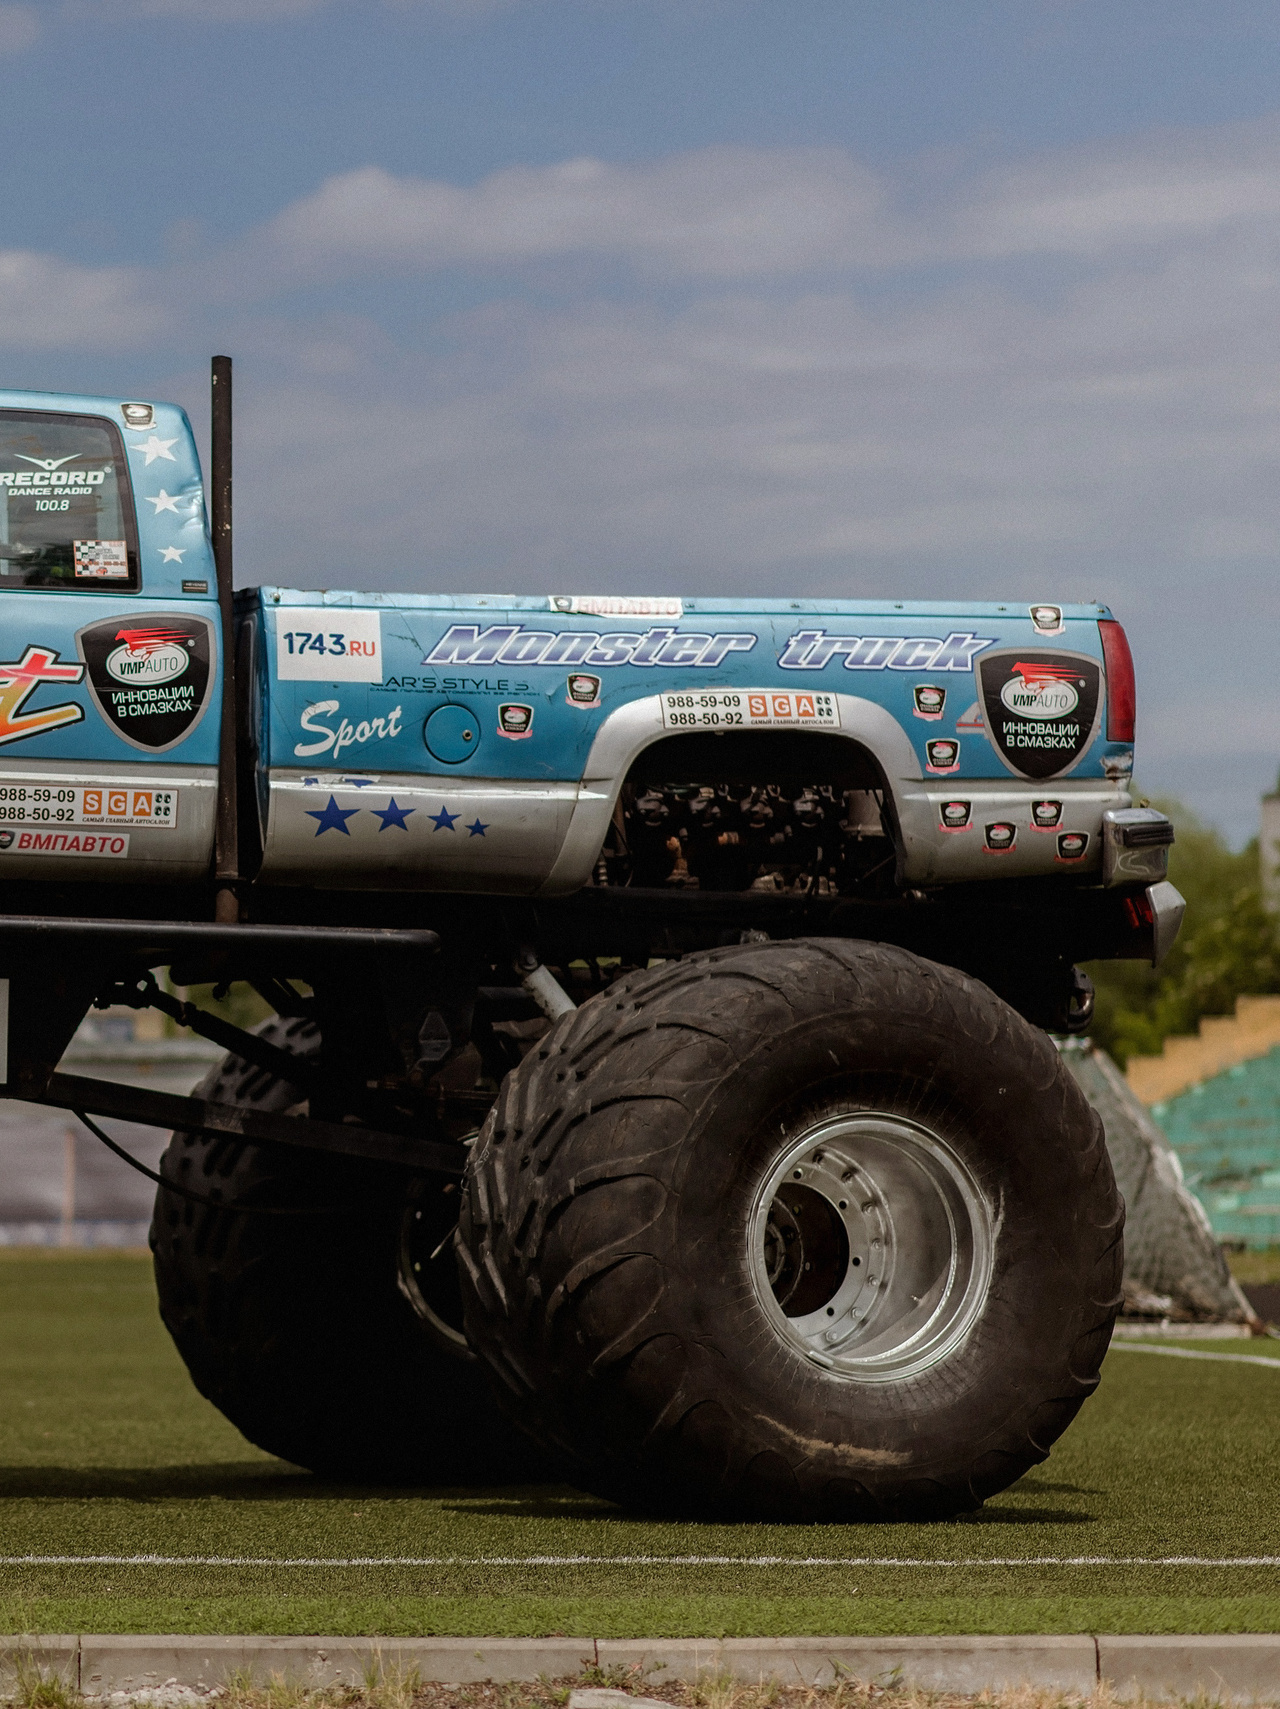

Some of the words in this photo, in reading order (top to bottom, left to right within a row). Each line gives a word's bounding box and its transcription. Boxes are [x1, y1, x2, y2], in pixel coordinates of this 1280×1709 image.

[8, 488, 52, 496] DANCE
[53, 487, 92, 495] RADIO
[35, 500, 70, 511] 100.8
[283, 632, 375, 656] 1743.RU
[422, 625, 757, 666] Monster
[778, 629, 1001, 672] truck
[119, 657, 178, 675] VMPAUTO
[371, 677, 437, 687] AR'S
[442, 679, 509, 691] STYLE
[112, 685, 195, 704] ИННОВАЦИИ
[667, 695, 741, 708] 988-59-09
[1013, 695, 1068, 708] VMPAUTO
[118, 706, 127, 717] В
[128, 700, 192, 717] СМАЗКАХ
[749, 696, 815, 716] SGA
[670, 713, 744, 725] 988-50-92
[294, 700, 402, 759] Sport
[1003, 722, 1080, 736] ИННОВАЦИИ
[1006, 736, 1015, 747] В
[1017, 736, 1076, 749] СМАЗКАХ
[0, 788, 75, 802] 988-59-09
[84, 791, 151, 815] SGA
[18, 833, 125, 854] ВМПАВТО
